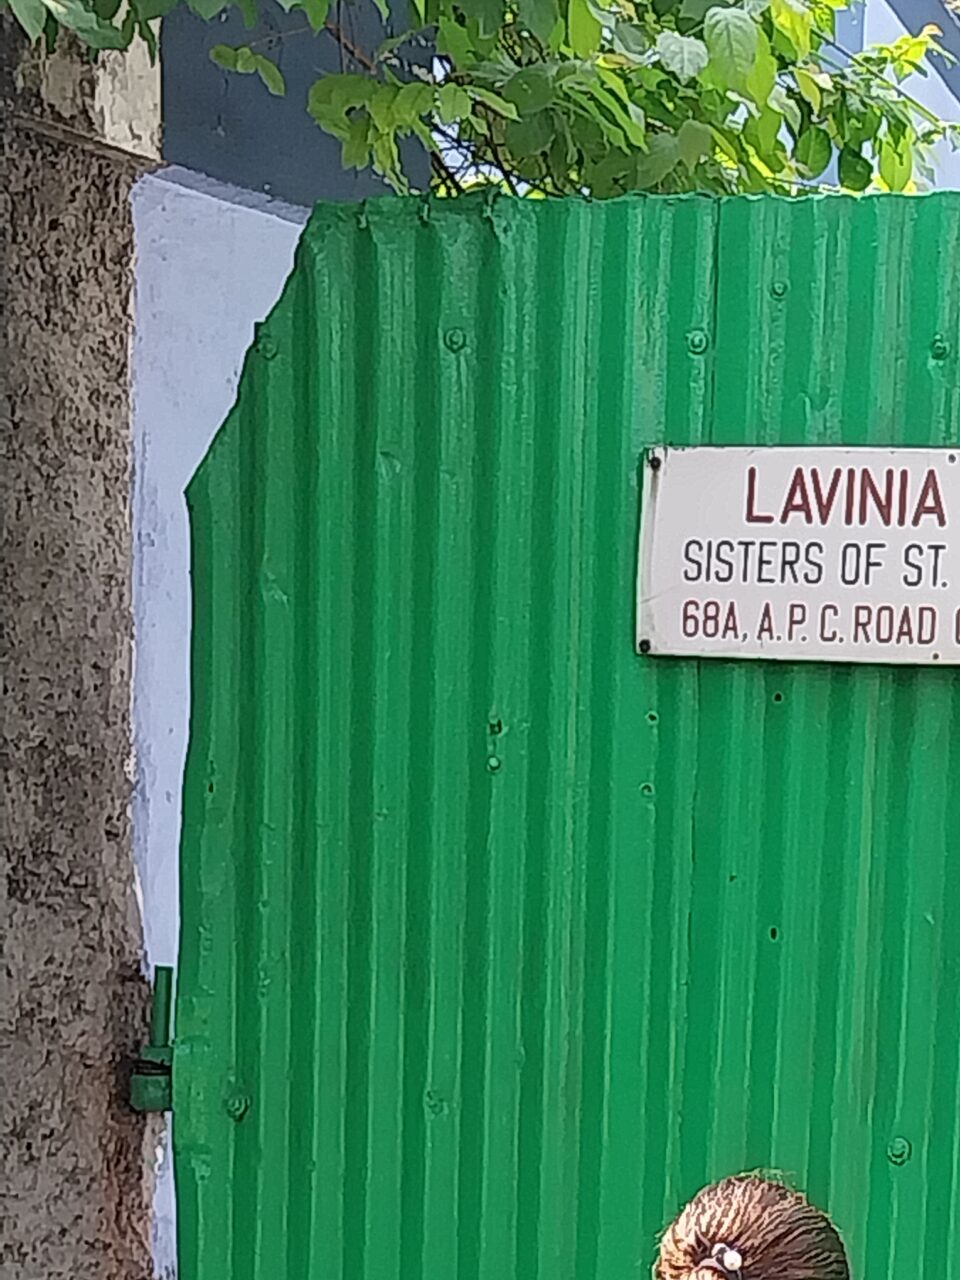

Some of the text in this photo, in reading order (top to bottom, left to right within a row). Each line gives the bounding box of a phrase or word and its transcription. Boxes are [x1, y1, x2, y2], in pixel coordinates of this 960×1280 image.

[745, 466, 947, 528] LAVINIA
[683, 539, 824, 585] SISTERS
[840, 542, 887, 586] OF
[902, 543, 948, 588] ST.
[682, 599, 748, 642] 68A,
